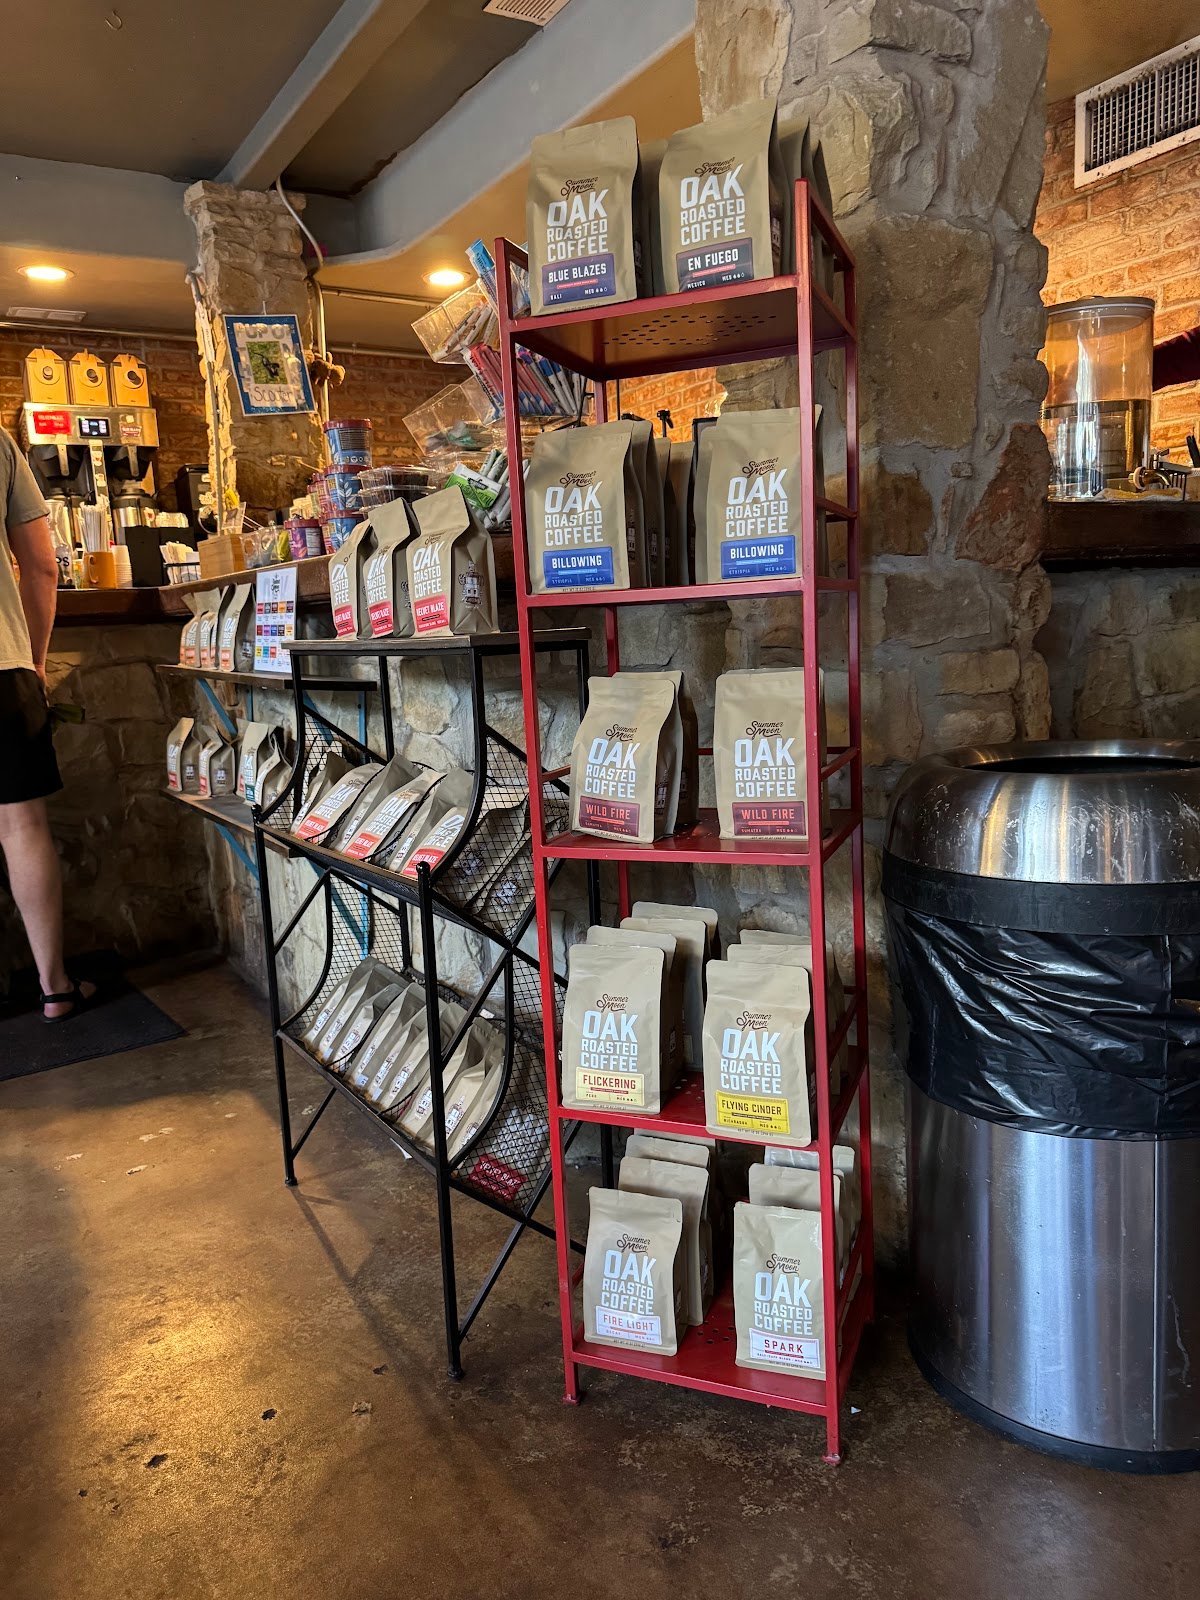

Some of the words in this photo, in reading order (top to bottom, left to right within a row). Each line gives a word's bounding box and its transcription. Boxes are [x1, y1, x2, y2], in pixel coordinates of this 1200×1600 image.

[680, 163, 744, 209] OAK
[547, 189, 608, 227] OAK
[680, 198, 745, 226] ROASTED
[547, 219, 608, 243] ROASTED
[681, 215, 745, 246] COFFEE
[547, 234, 609, 262] COFFEE
[688, 256, 701, 271] EN
[705, 248, 739, 267] FUEGO
[548, 269, 569, 283] BLUE
[572, 263, 607, 279] BLAZES
[254, 386, 293, 402] Scooter
[544, 481, 603, 513] OAK
[727, 469, 788, 505] OAK
[544, 510, 602, 528] ROASTED
[726, 500, 788, 519] ROASTED
[545, 525, 604, 546] COFFEE
[726, 515, 788, 538] COFFEE
[413, 541, 444, 570] OAK
[552, 555, 602, 569] BILLOWING
[730, 544, 784, 559] BILLOWING
[413, 564, 441, 583] ROASTED
[414, 577, 442, 599] COFFEE
[588, 738, 640, 769] OAK
[735, 737, 796, 767] OAK
[586, 764, 636, 783] ROASTED
[735, 767, 796, 780] ROASTED
[584, 777, 636, 798] COFFEE
[735, 781, 797, 797] COFFEE
[585, 803, 607, 816] WILD
[611, 808, 631, 820] FIRE
[741, 809, 768, 819] WILD
[772, 809, 795, 819] FIRE
[582, 1010, 638, 1043] OAK
[581, 1038, 638, 1056] ROASTED
[721, 1028, 781, 1063] OAK
[580, 1052, 638, 1072] COFFEE
[720, 1058, 781, 1077] ROASTED
[583, 1074, 636, 1090] FLICKERING
[720, 1073, 782, 1094] COFFEE
[721, 1099, 749, 1112] FLYING
[751, 1104, 782, 1116] CINDER
[603, 1249, 657, 1287] OAK
[602, 1278, 654, 1300] ROASTED
[754, 1272, 811, 1308] OAK
[601, 1292, 654, 1315] COFFEE
[754, 1300, 812, 1320] ROASTED
[603, 1314, 623, 1327] FIRE
[626, 1320, 654, 1331] LIGHT
[754, 1313, 813, 1335] COFFEE
[764, 1340, 803, 1354] SPARK
